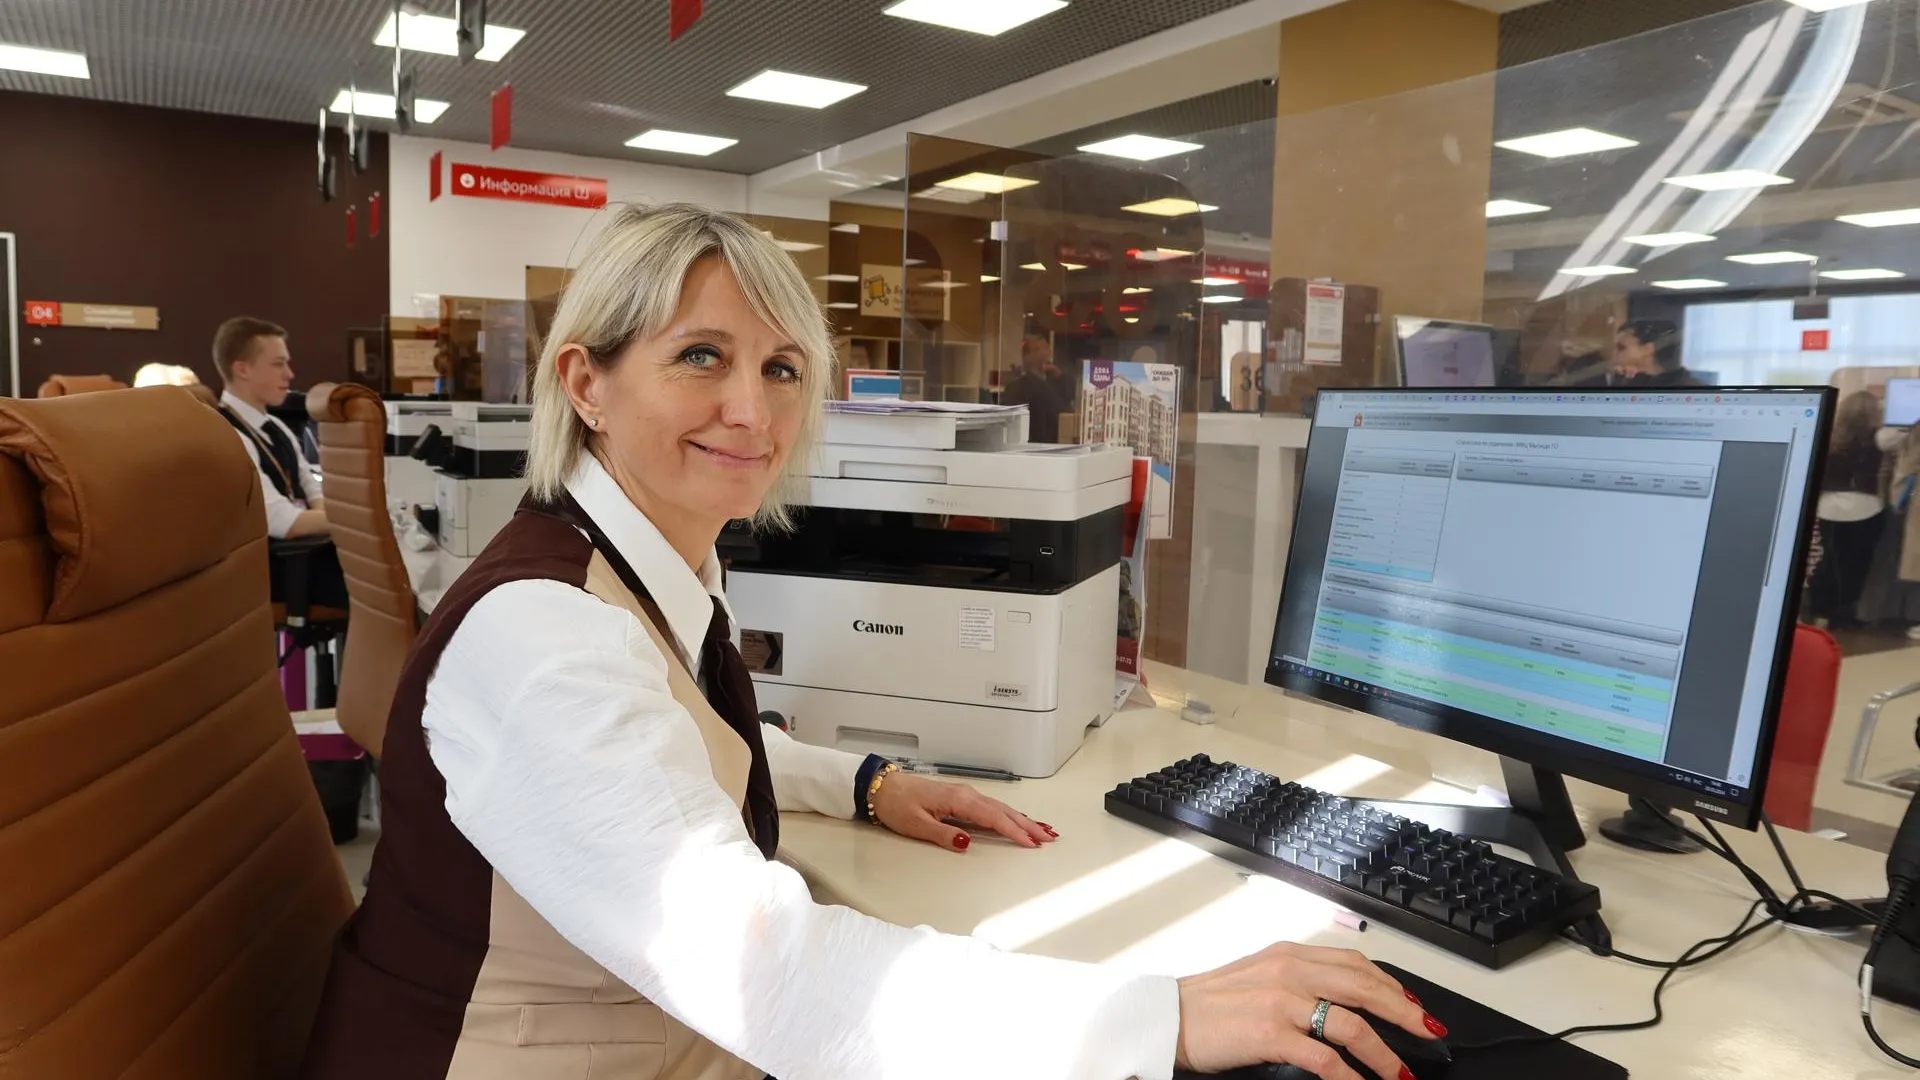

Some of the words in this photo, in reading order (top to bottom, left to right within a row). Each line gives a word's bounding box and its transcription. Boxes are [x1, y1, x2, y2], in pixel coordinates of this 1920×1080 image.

[479, 175, 571, 197] Информация
[853, 619, 904, 636] Canon
[1694, 800, 1729, 815] SAMSUNG
